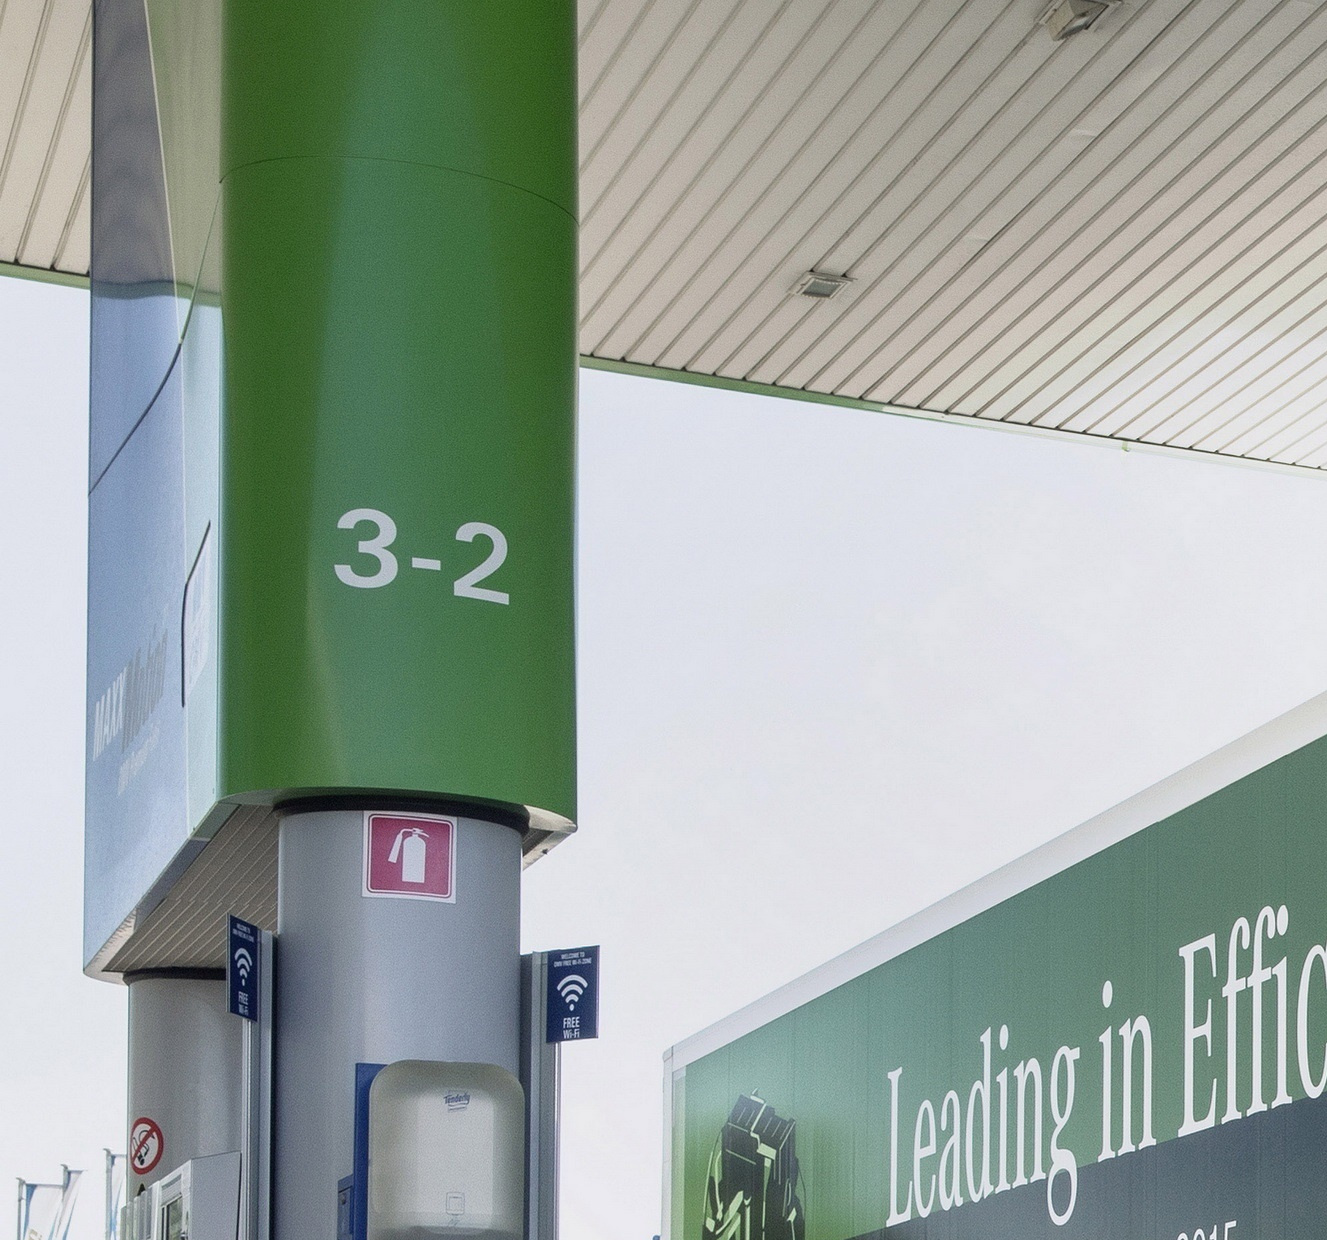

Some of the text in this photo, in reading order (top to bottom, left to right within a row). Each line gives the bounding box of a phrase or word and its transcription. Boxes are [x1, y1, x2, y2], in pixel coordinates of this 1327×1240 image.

[334, 507, 510, 606] 3-2
[563, 1016, 580, 1029] FREE
[563, 1028, 580, 1040] Wi-Fi
[886, 1023, 1080, 1227] Leading
[1098, 979, 1157, 1164] in
